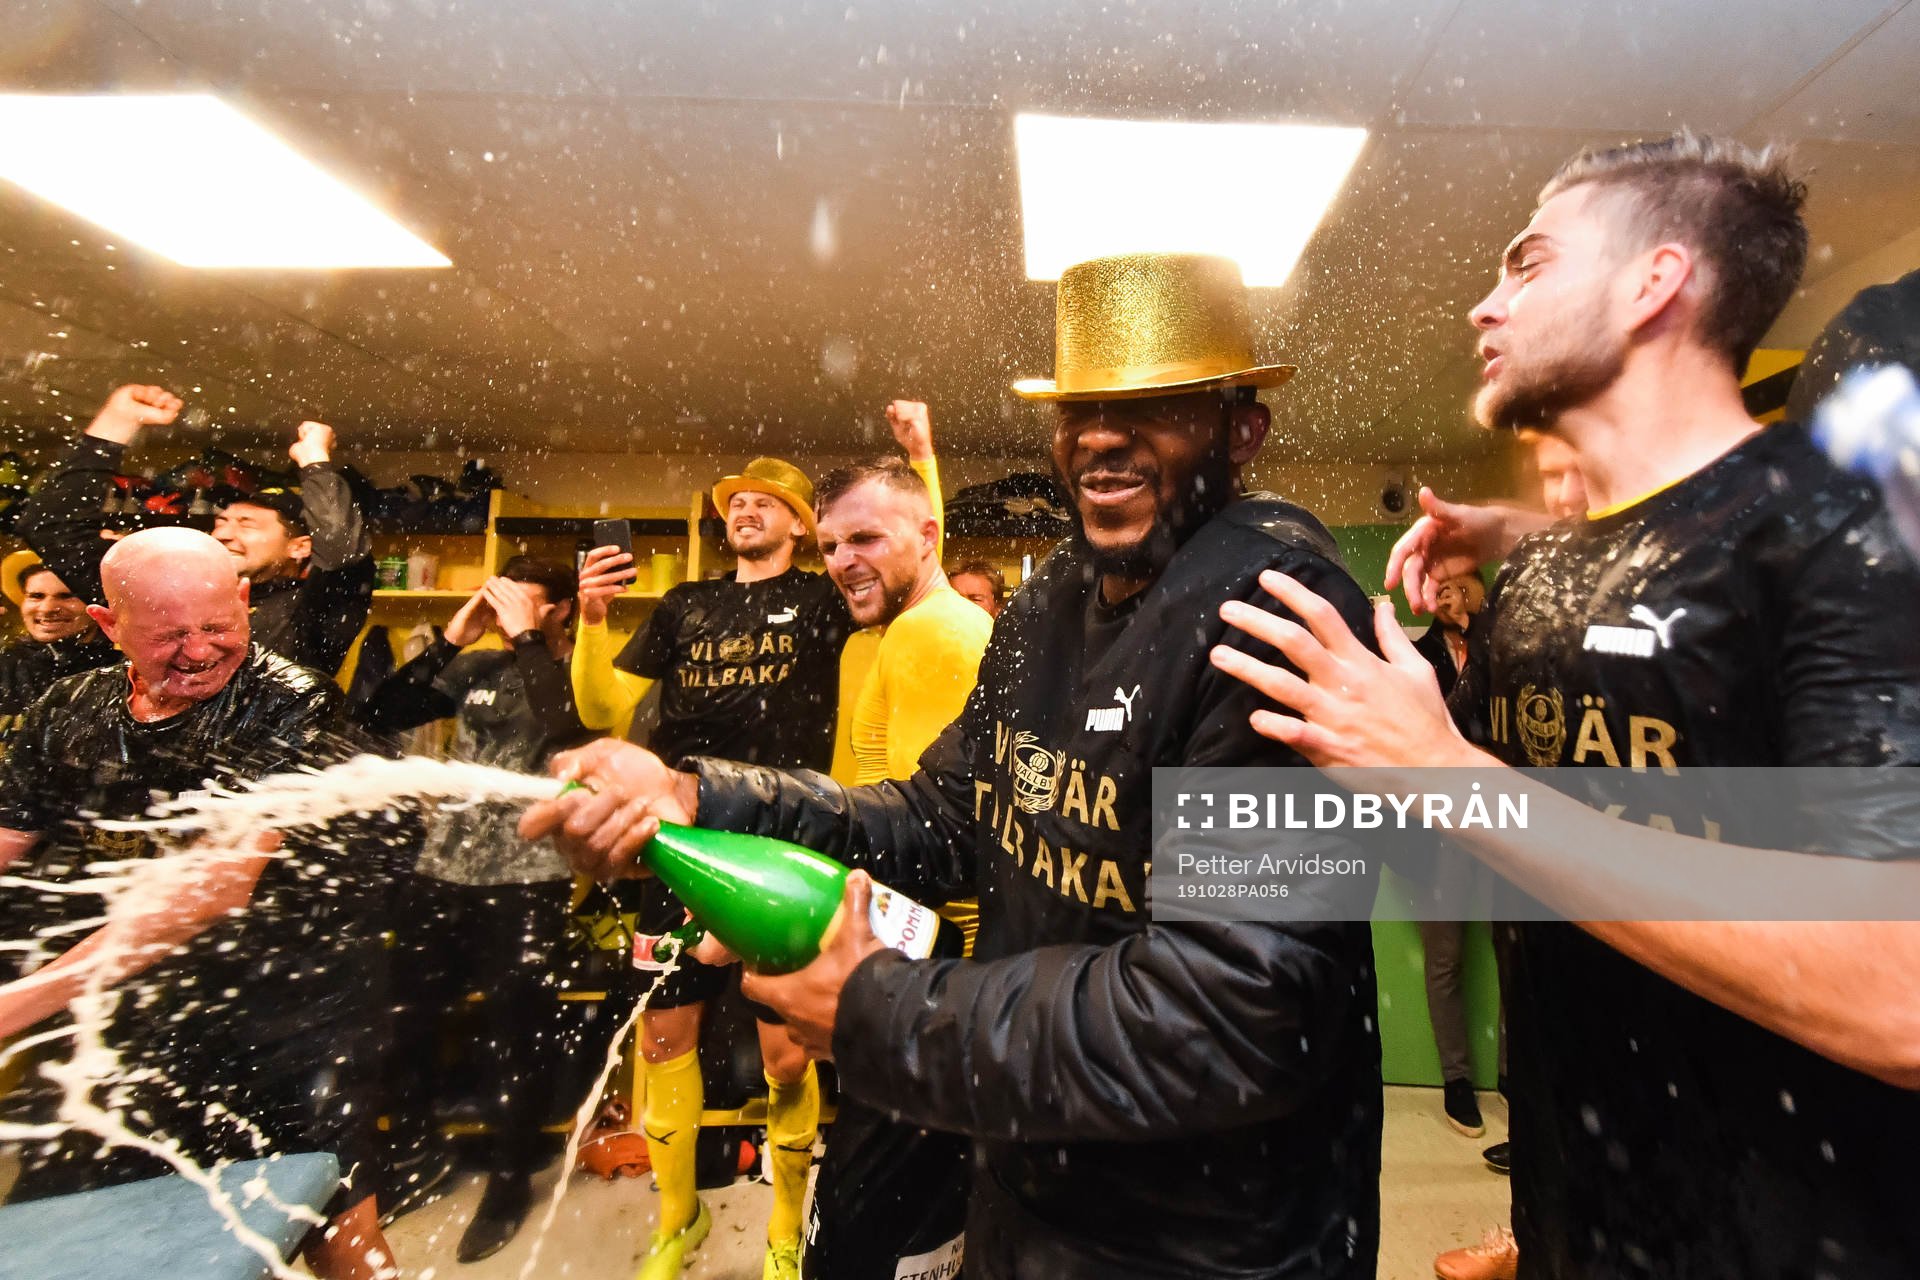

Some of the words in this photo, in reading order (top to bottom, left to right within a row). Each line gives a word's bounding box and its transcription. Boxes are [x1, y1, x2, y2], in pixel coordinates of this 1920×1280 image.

[760, 631, 793, 655] ÄR
[1085, 707, 1125, 731] PUMA
[1572, 693, 1681, 777] ÄR
[1062, 758, 1120, 831] ÄR
